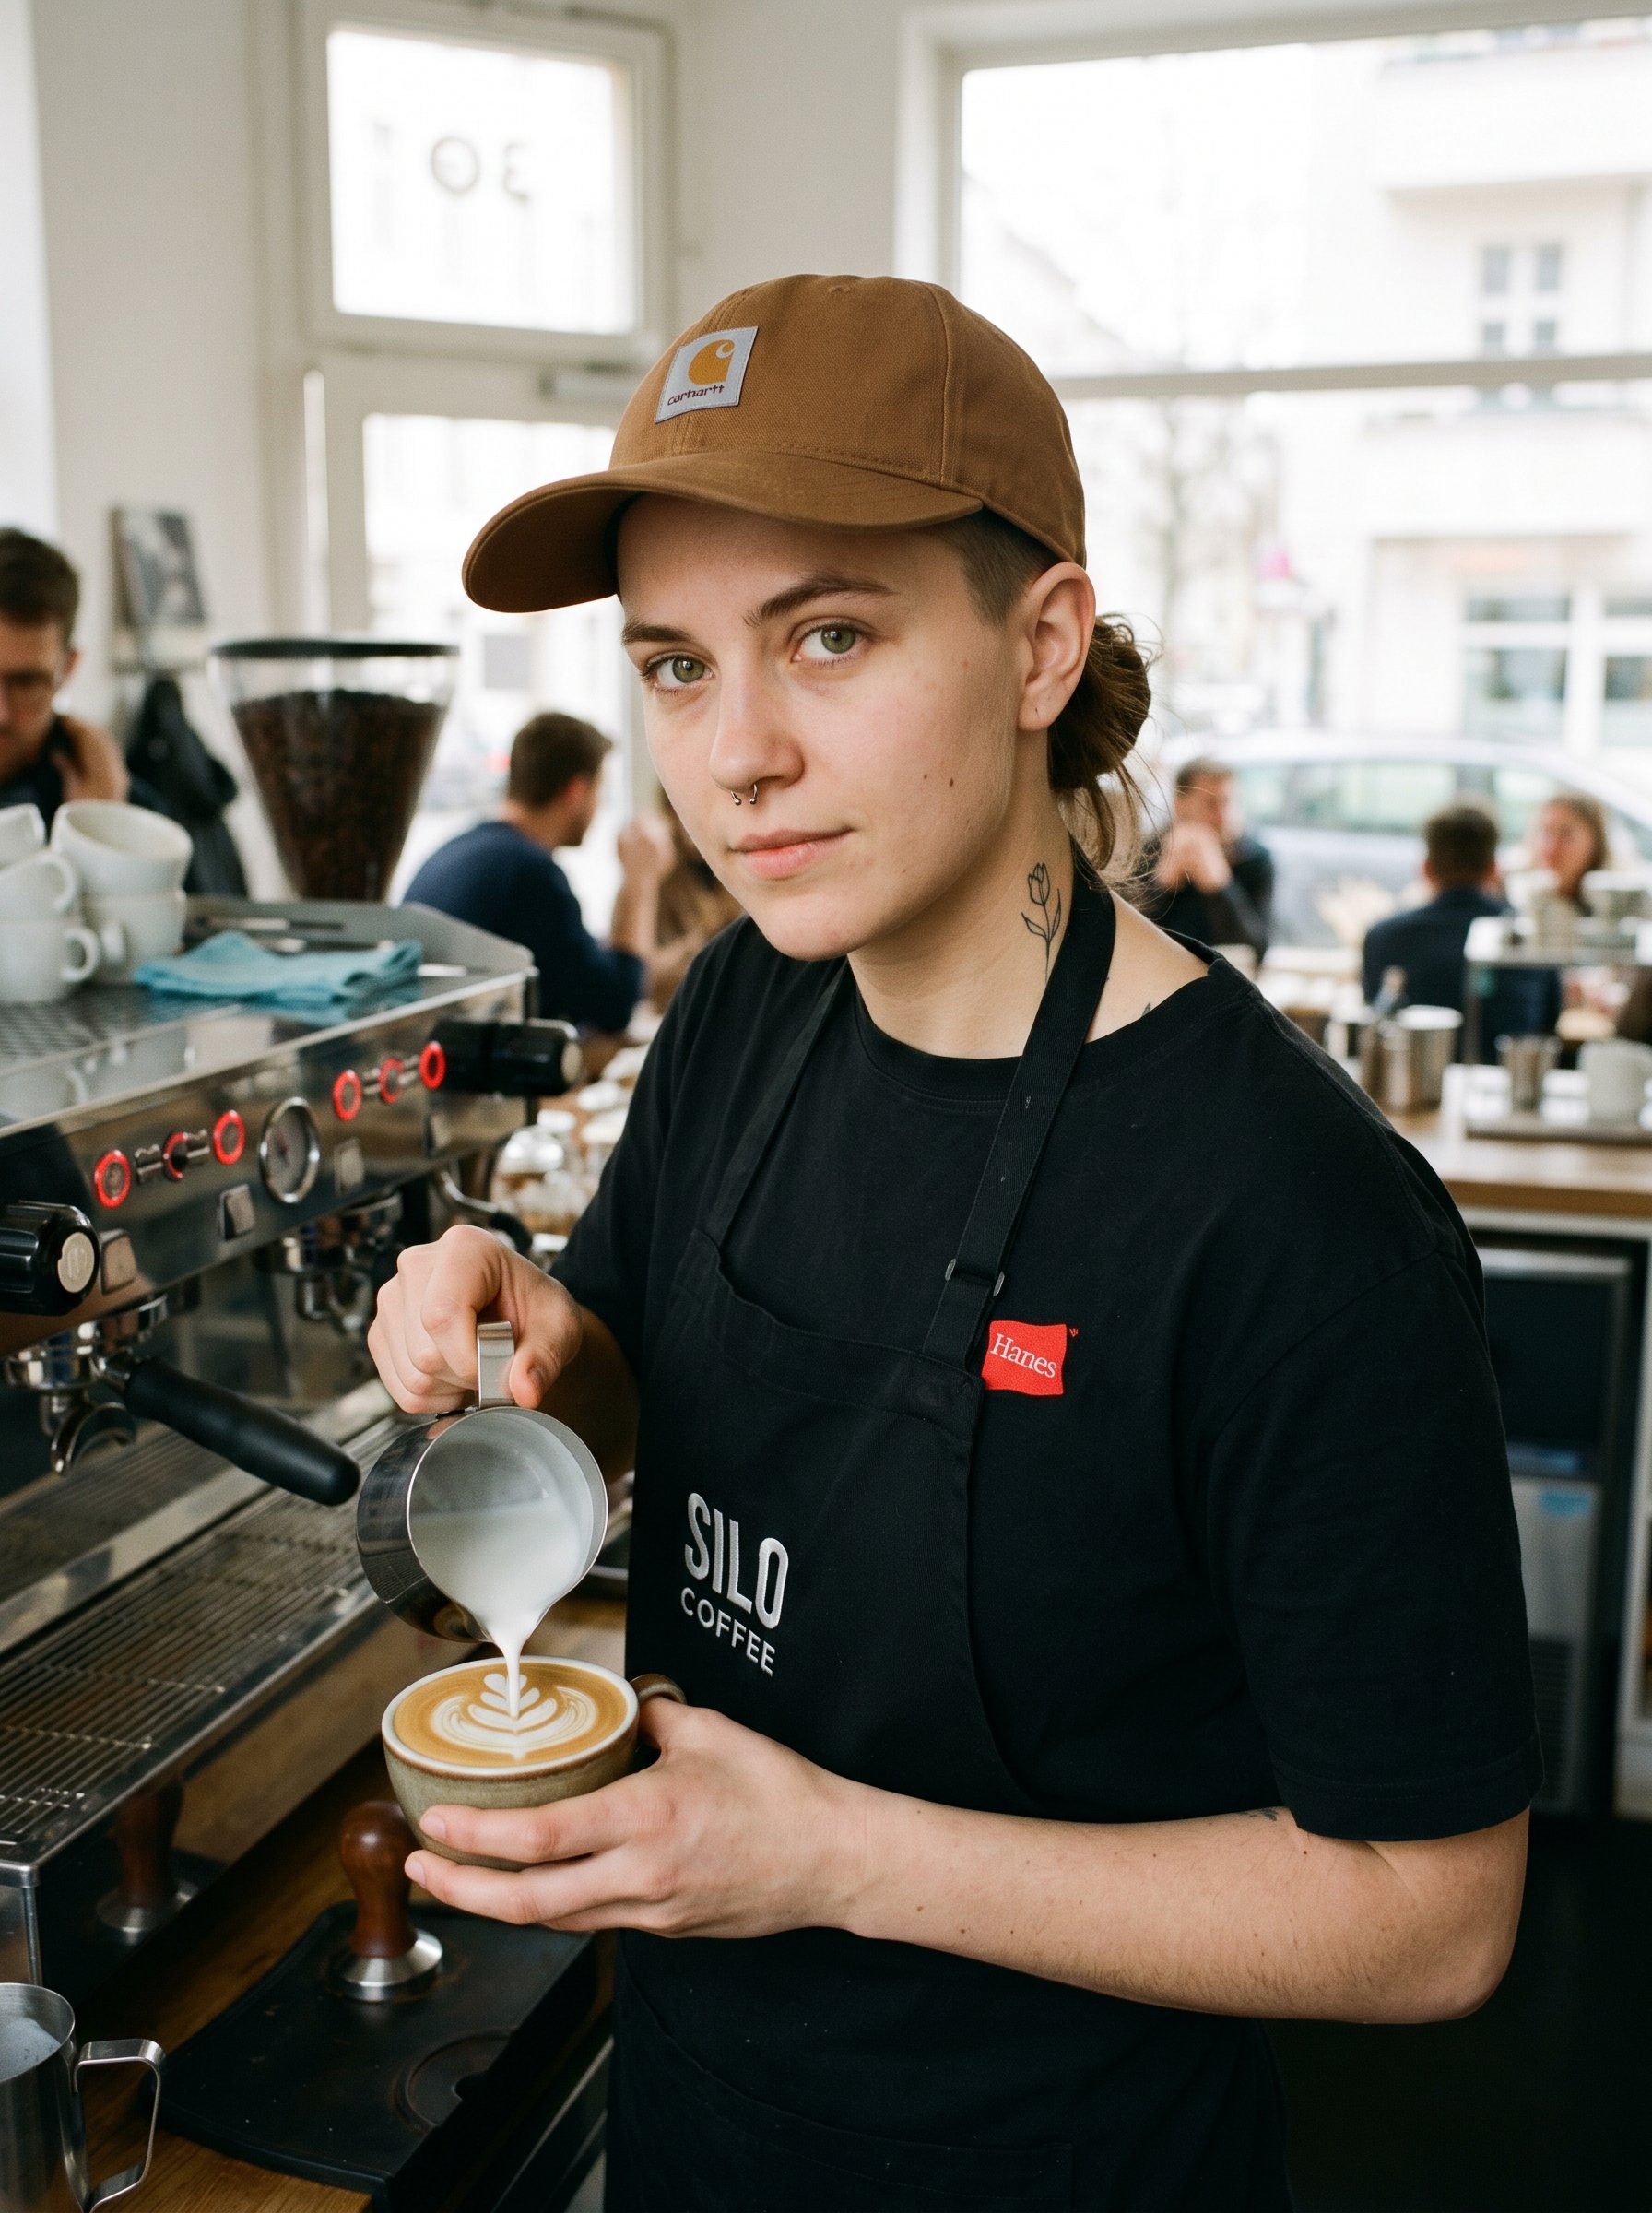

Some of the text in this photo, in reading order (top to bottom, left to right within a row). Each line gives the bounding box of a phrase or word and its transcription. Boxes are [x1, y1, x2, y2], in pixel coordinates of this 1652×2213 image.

[667, 385, 726, 406] carhartt
[990, 1333, 1057, 1378] Hanes
[684, 1492, 789, 1629] SILO
[680, 1586, 775, 1677] COFFEE
